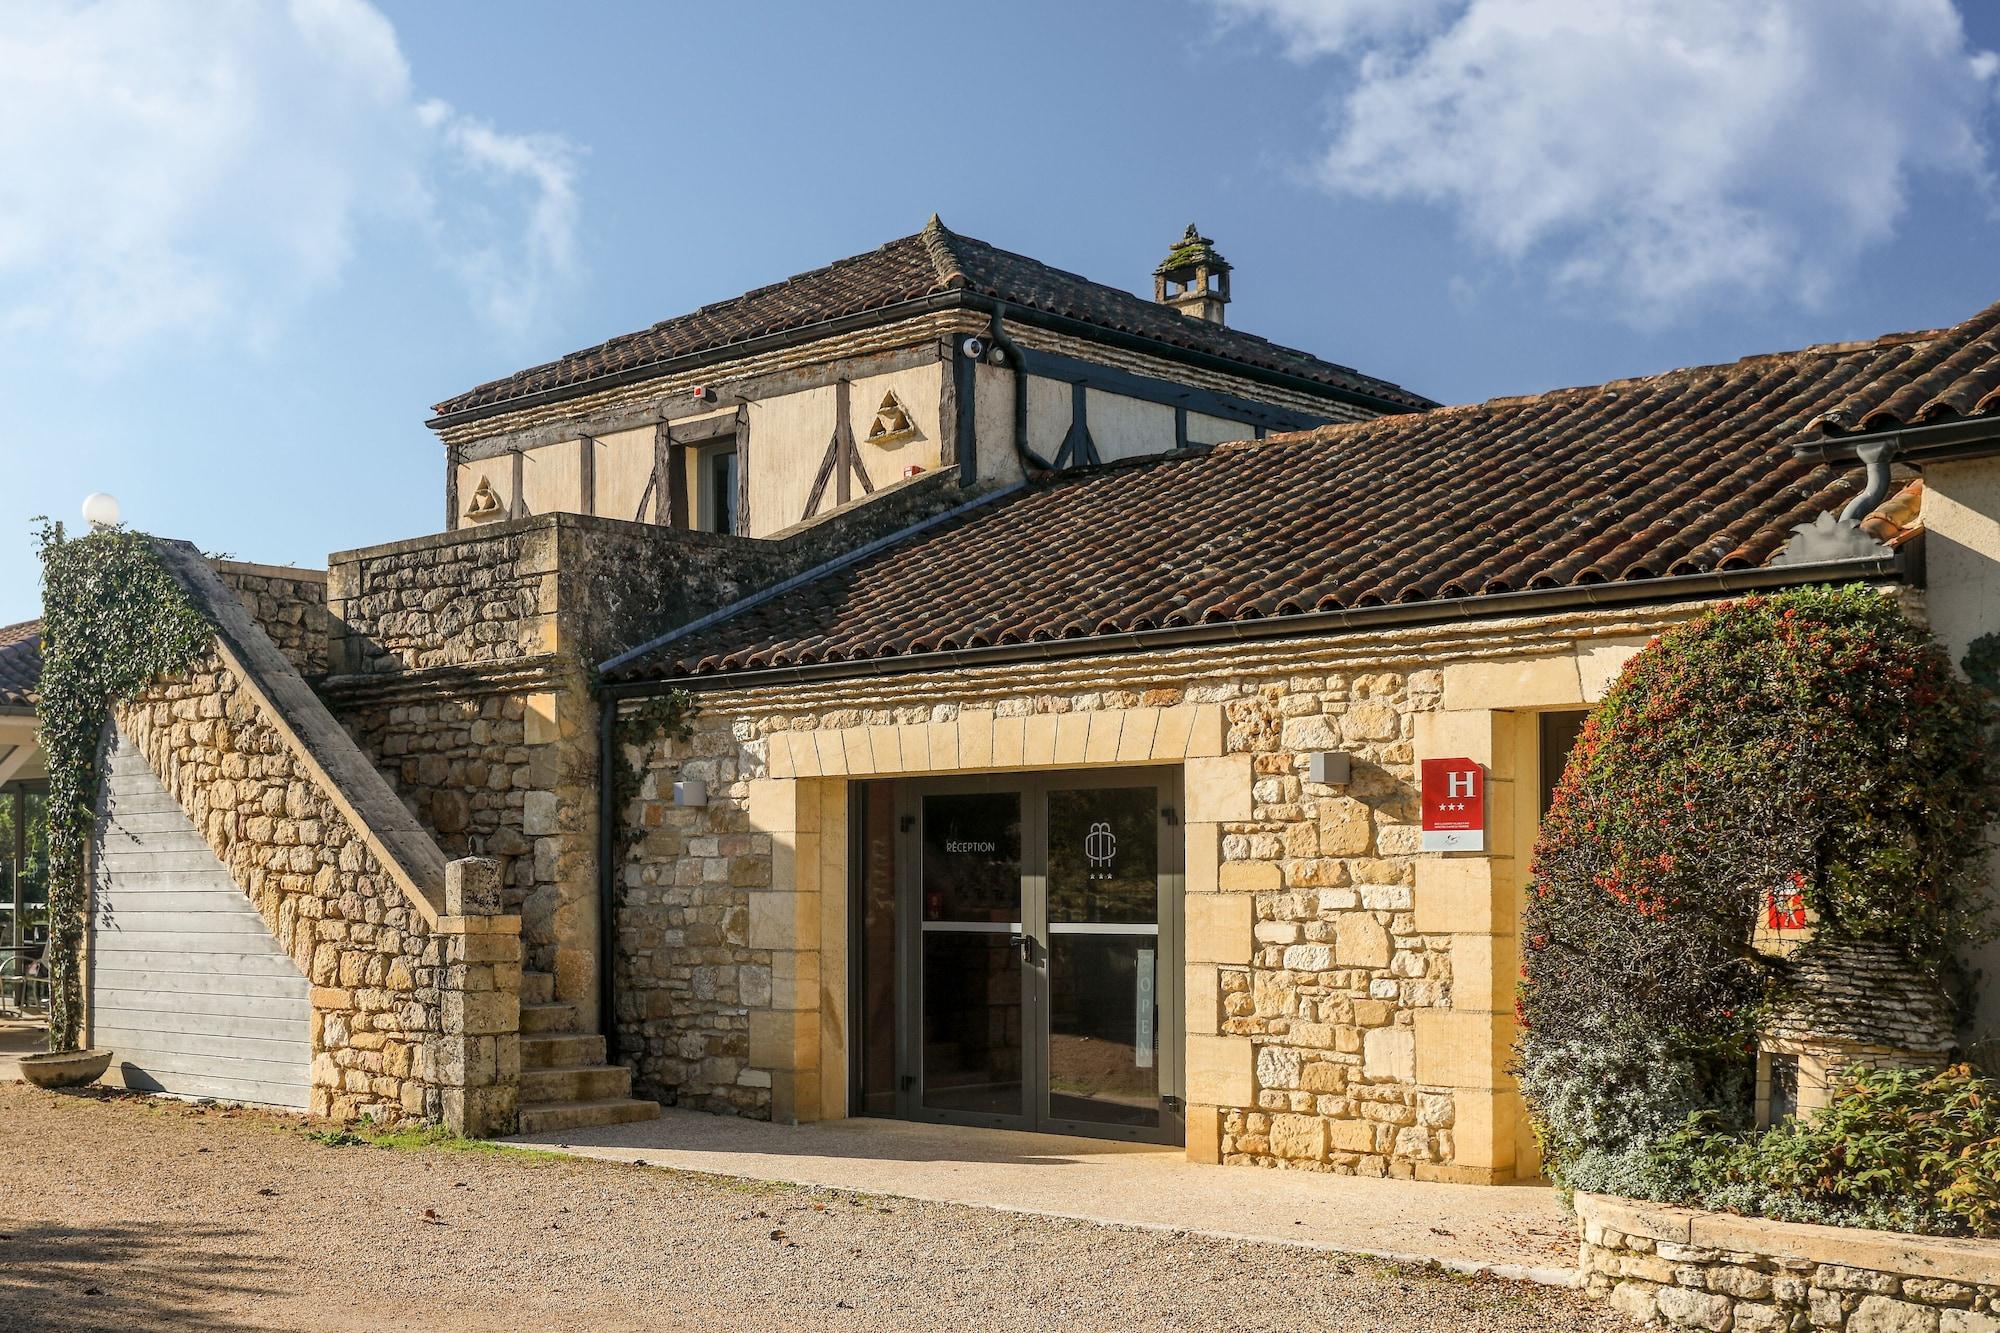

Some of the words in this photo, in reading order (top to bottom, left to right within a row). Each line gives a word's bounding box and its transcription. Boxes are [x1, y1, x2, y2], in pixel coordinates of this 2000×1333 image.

[1446, 771, 1477, 798] H
[946, 841, 995, 852] RÉCEPTION
[1140, 976, 1152, 1057] OPEN
